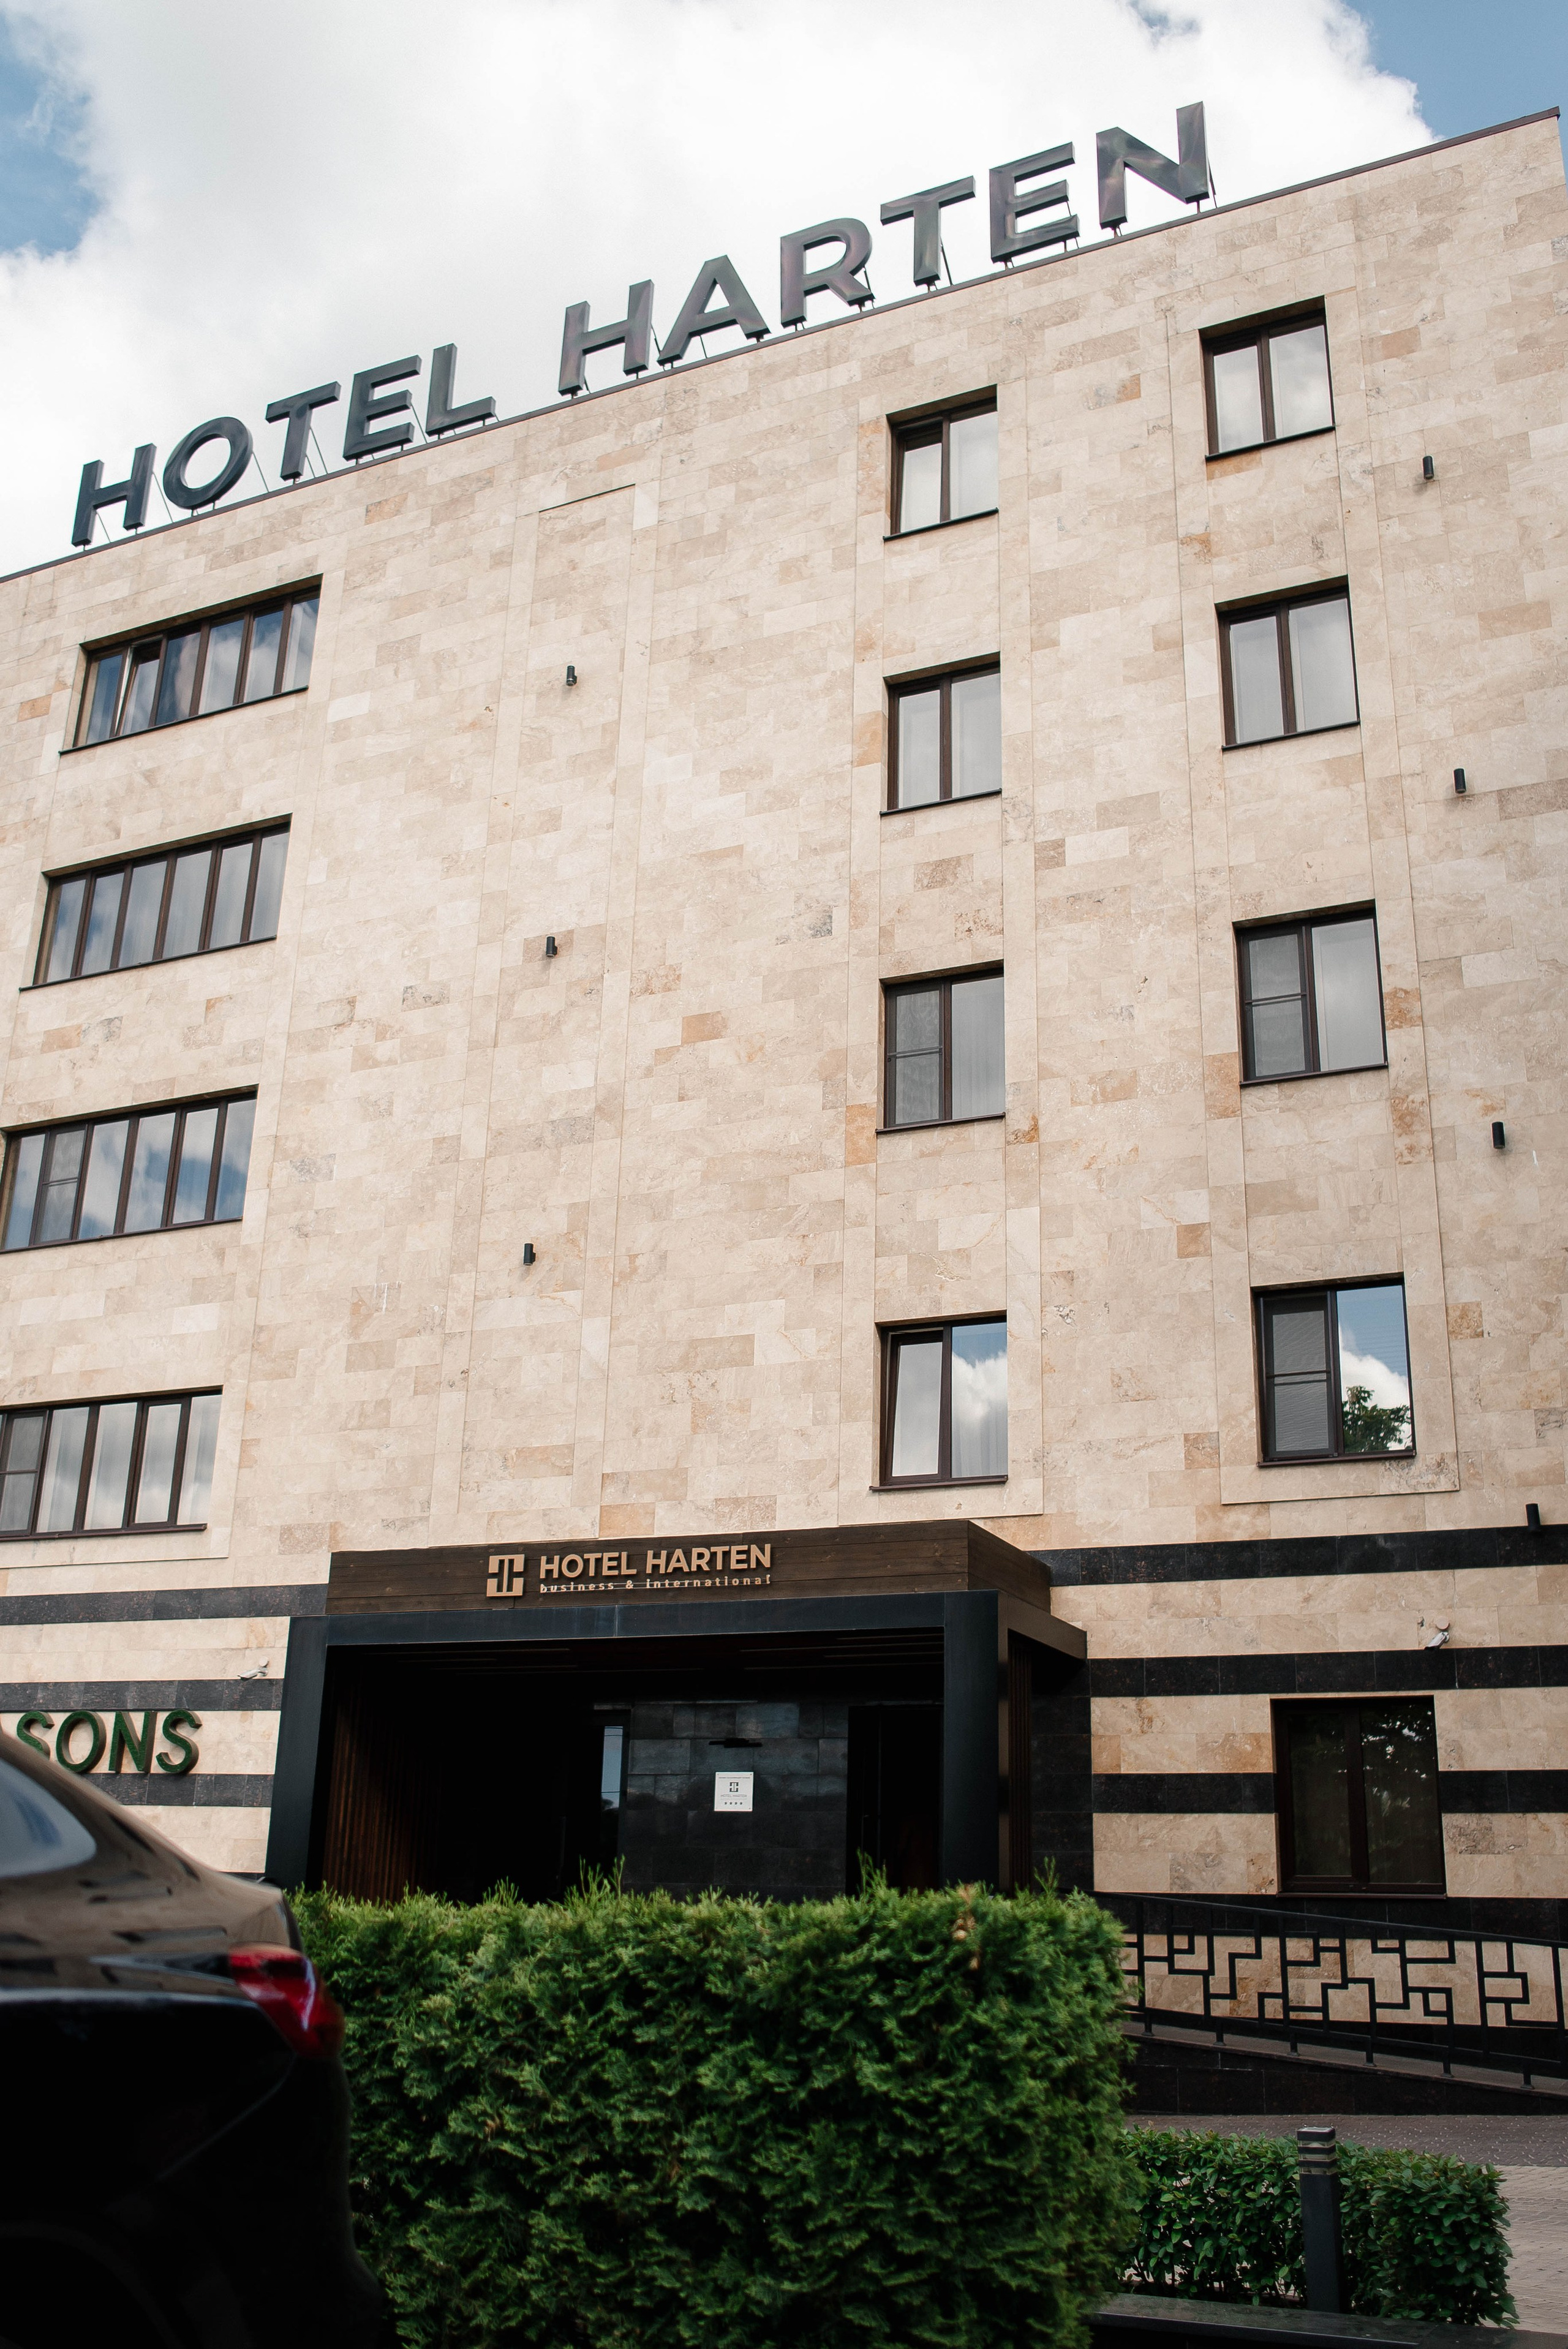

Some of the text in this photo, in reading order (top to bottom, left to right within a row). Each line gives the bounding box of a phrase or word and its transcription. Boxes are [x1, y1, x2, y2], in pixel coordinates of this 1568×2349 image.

[71, 100, 1211, 548] HOTEL HARTEN
[540, 1544, 771, 1579] HOTEL HARTEN
[540, 1574, 771, 1594] business & international
[16, 1710, 202, 1774] SONS
